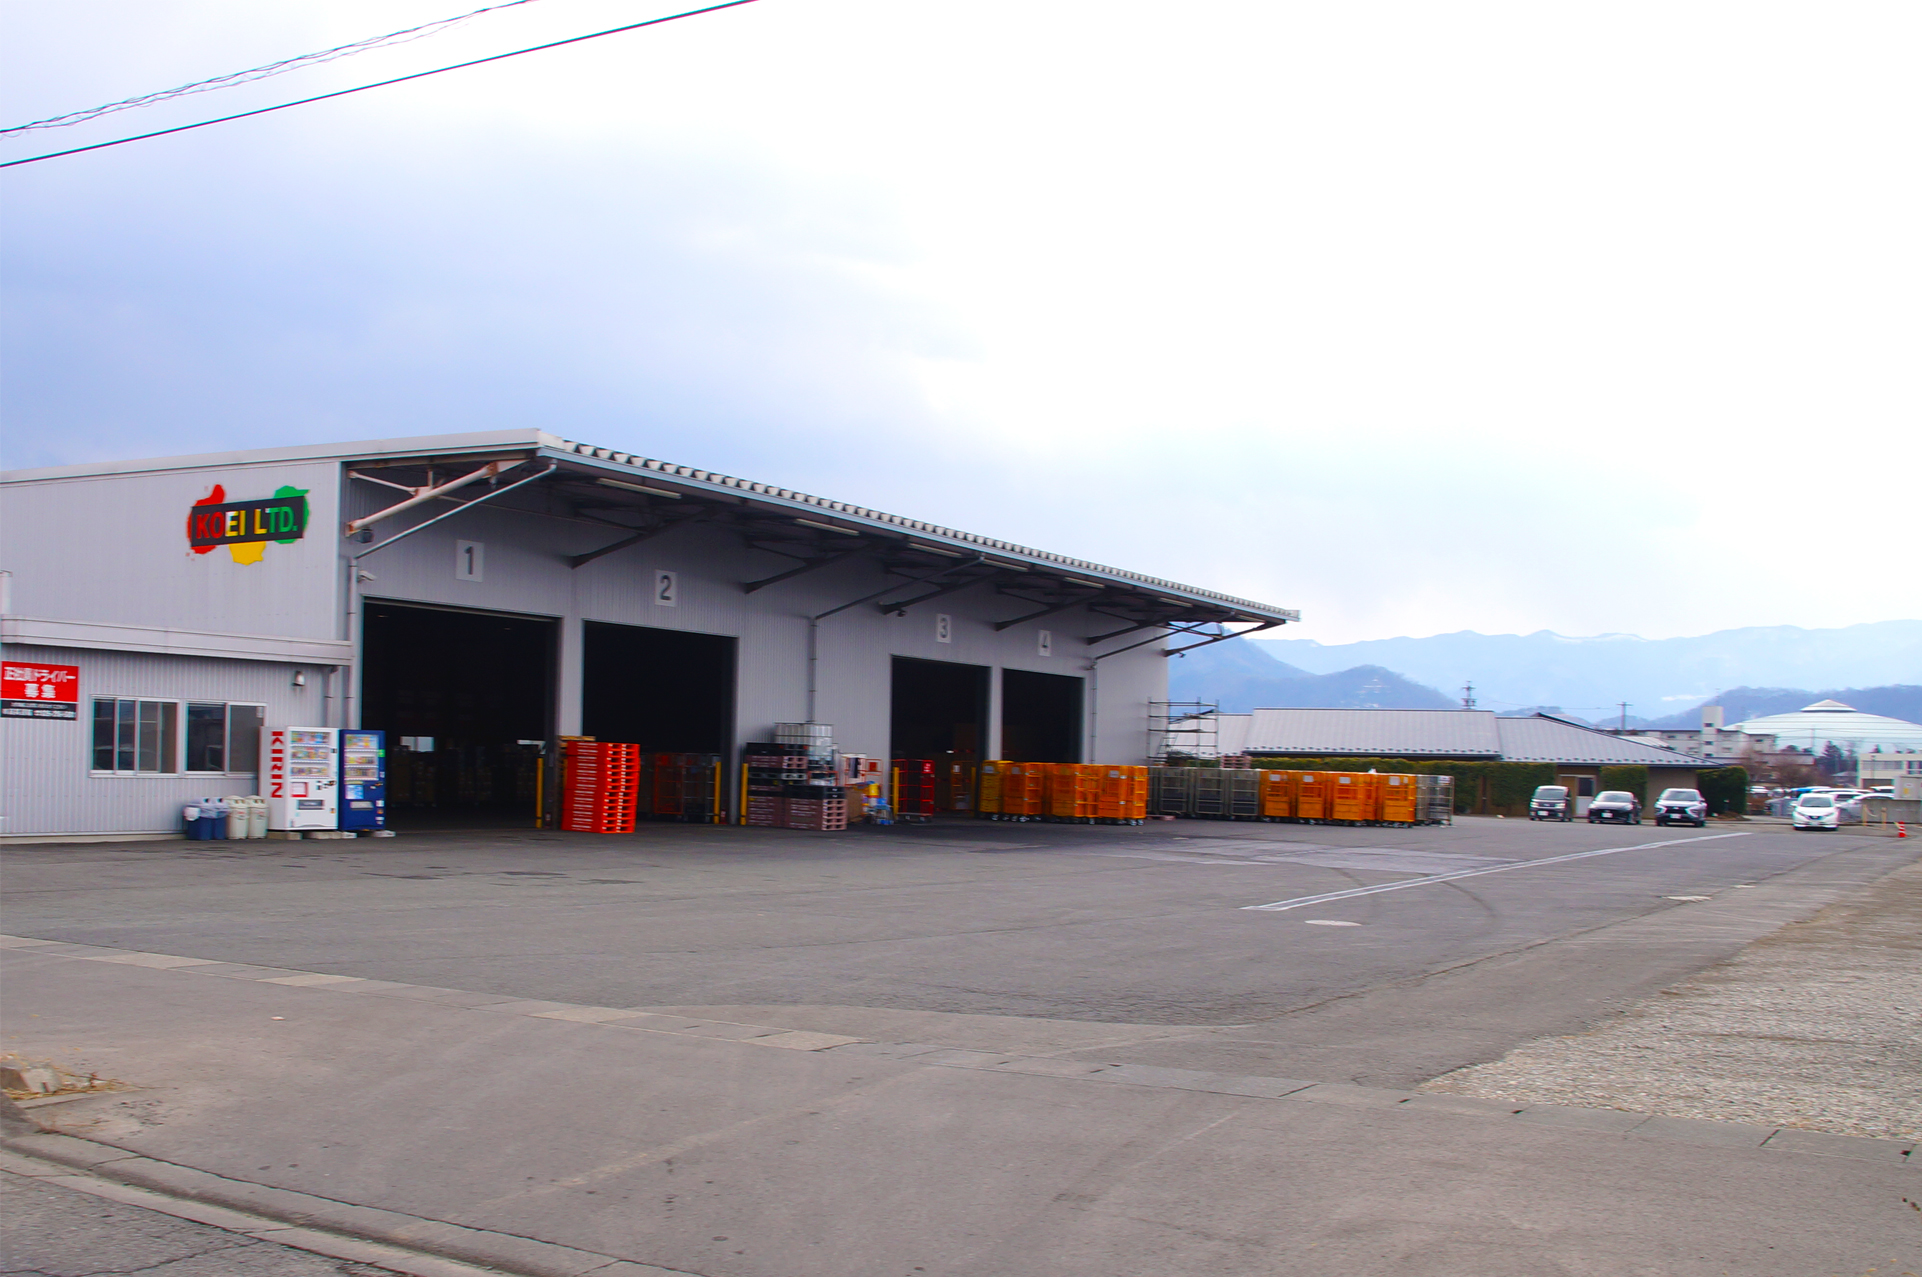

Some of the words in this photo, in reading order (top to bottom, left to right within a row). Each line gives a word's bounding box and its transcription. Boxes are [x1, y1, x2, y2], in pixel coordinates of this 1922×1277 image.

[196, 510, 246, 539] KOEI
[253, 506, 298, 535] LTD.
[464, 546, 474, 575] 1
[660, 574, 672, 601] 2
[939, 617, 949, 639] 3
[270, 731, 284, 798] KIRIN
